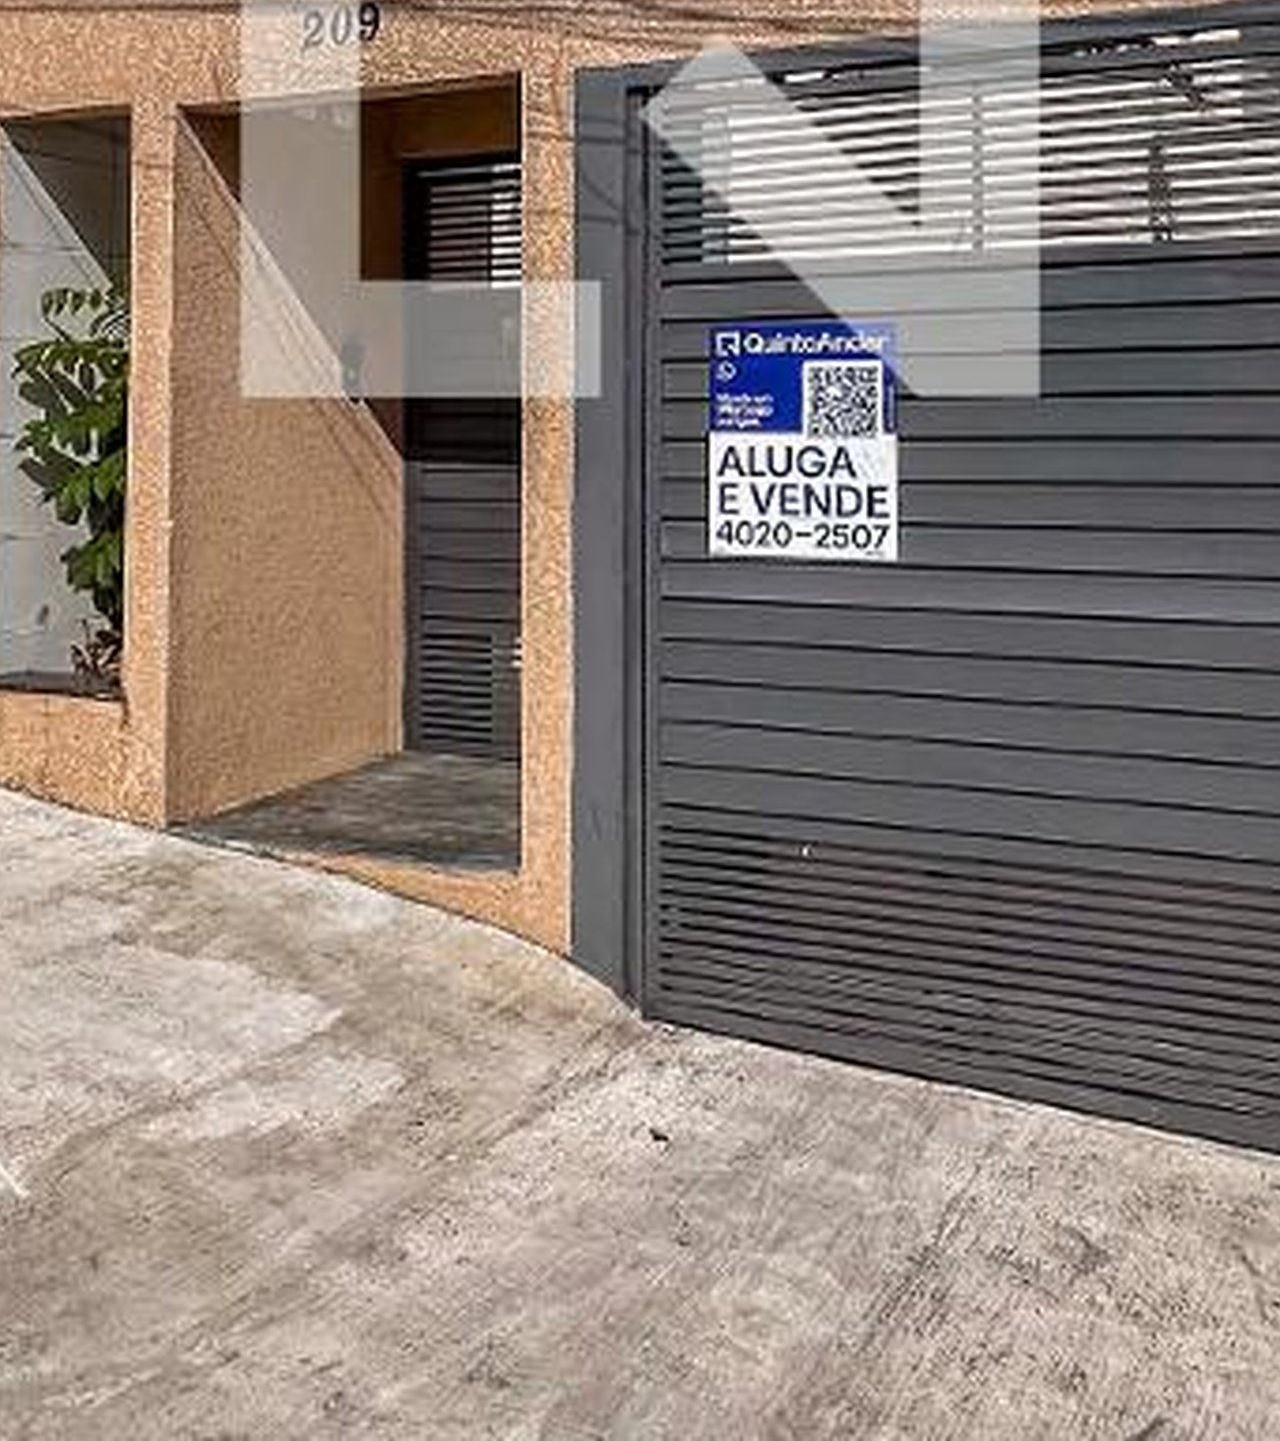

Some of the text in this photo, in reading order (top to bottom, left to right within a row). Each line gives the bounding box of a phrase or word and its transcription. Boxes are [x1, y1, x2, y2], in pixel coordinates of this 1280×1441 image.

[300, 1, 380, 52] 209
[716, 445, 857, 479] ALUGA
[719, 482, 891, 519] E VENDE
[715, 519, 891, 550] 4020-2507
